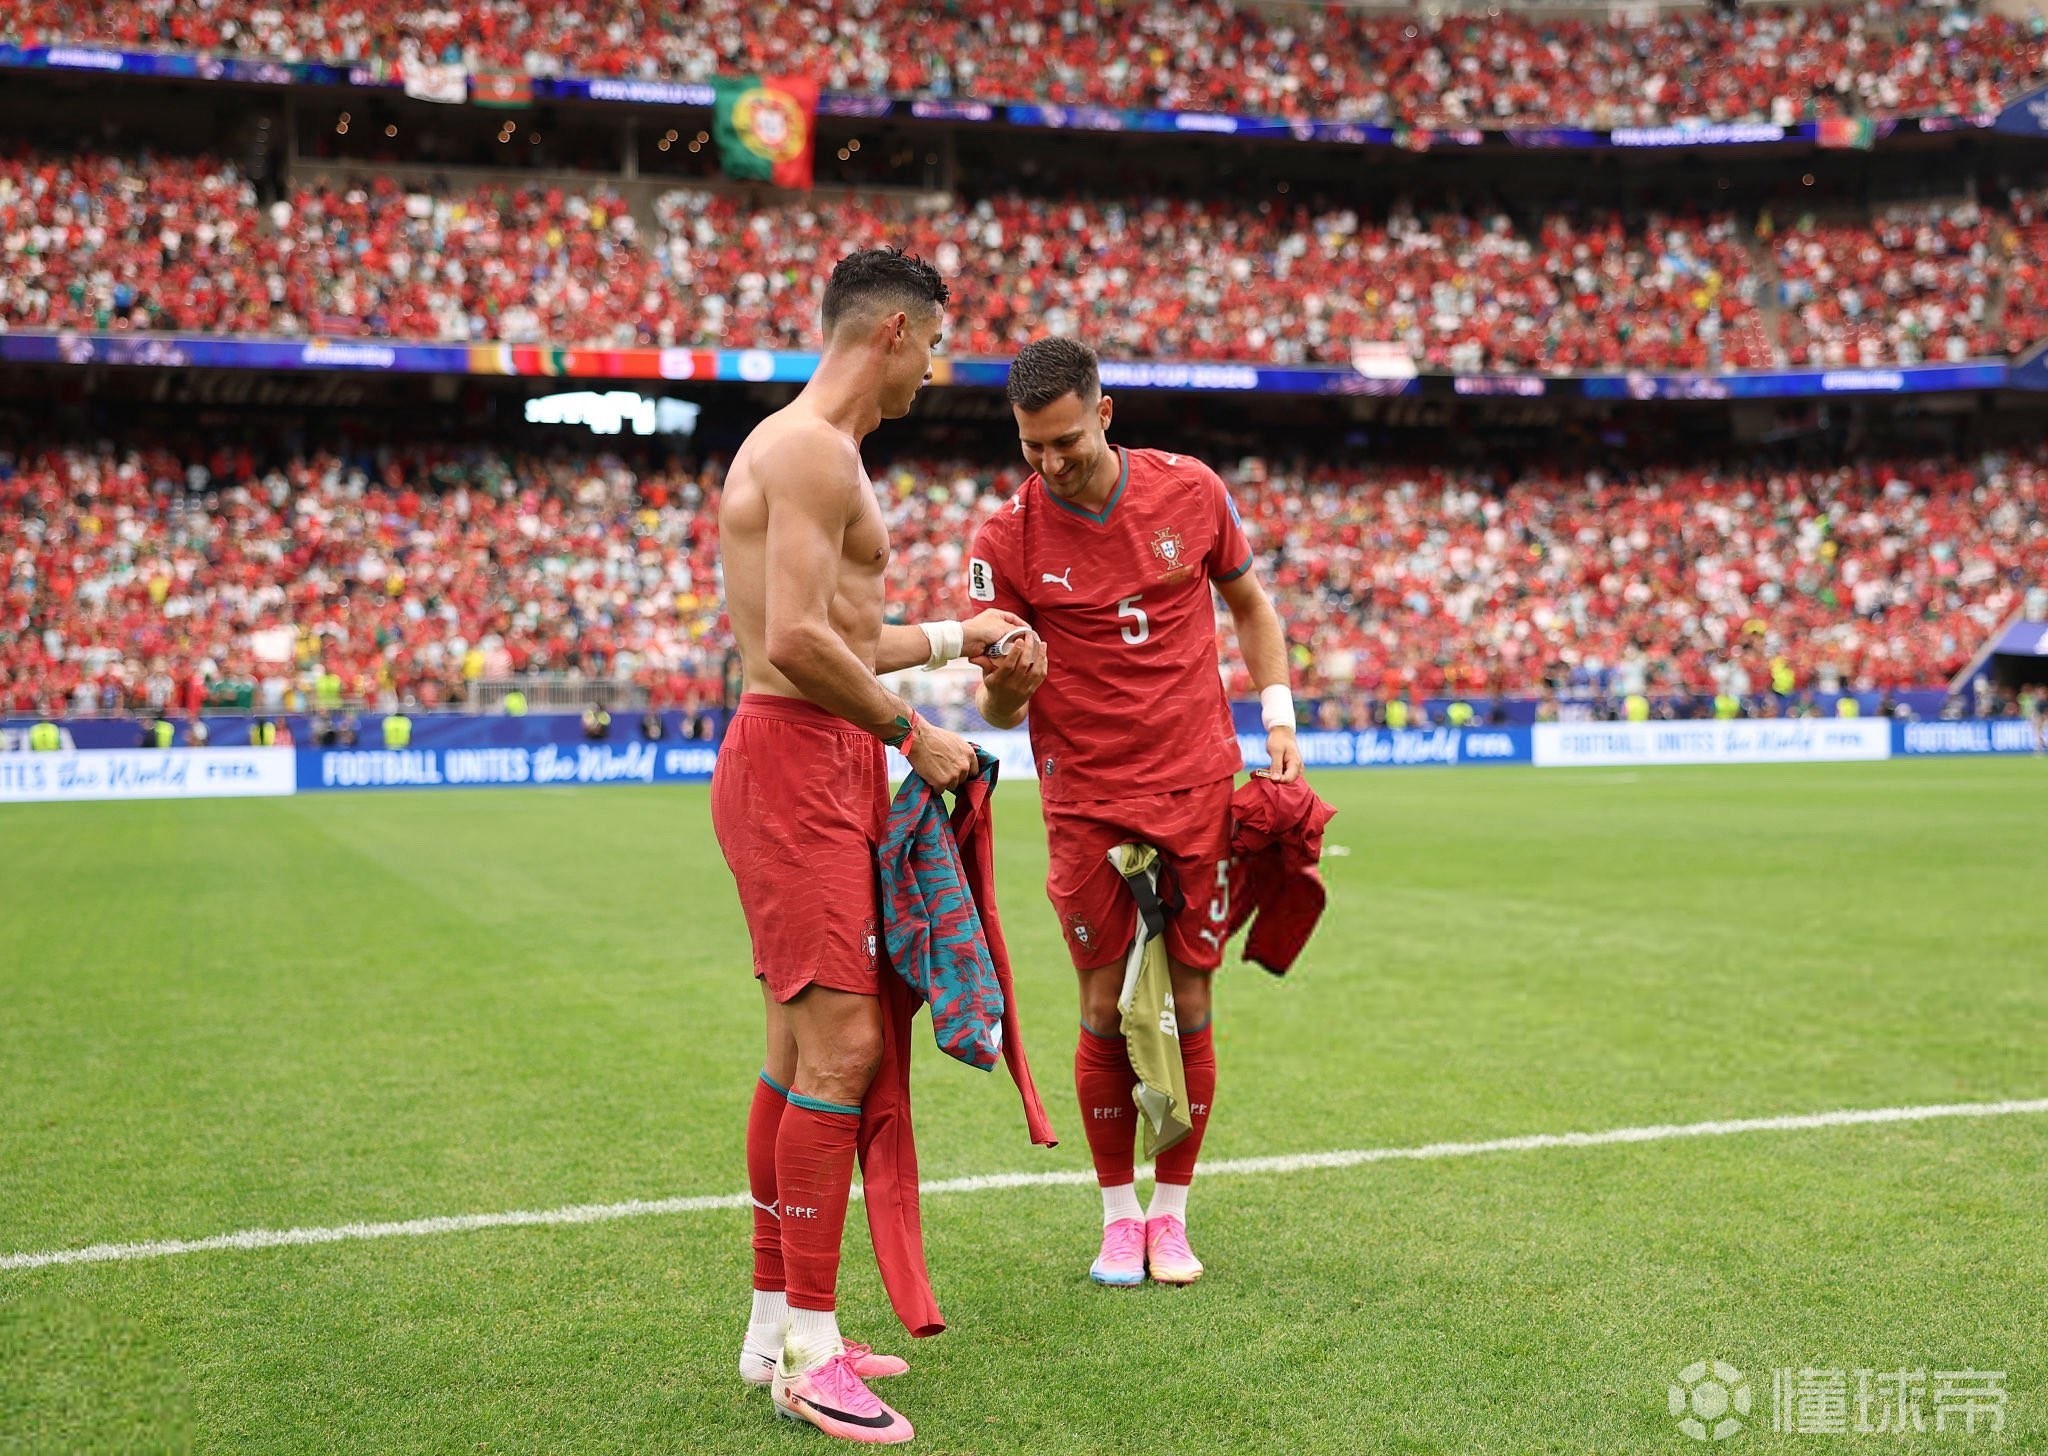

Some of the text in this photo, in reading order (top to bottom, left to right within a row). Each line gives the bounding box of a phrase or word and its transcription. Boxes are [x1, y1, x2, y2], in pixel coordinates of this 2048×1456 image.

[1116, 594, 1149, 645] 5
[322, 750, 442, 785] FOOTBALL
[445, 747, 530, 783] UNITES
[531, 743, 578, 783] the
[577, 741, 657, 783] World
[1354, 727, 1393, 765] the
[1392, 726, 1461, 765] World
[1466, 733, 1514, 757] FIFA
[785, 1205, 818, 1219] F.P.F.
